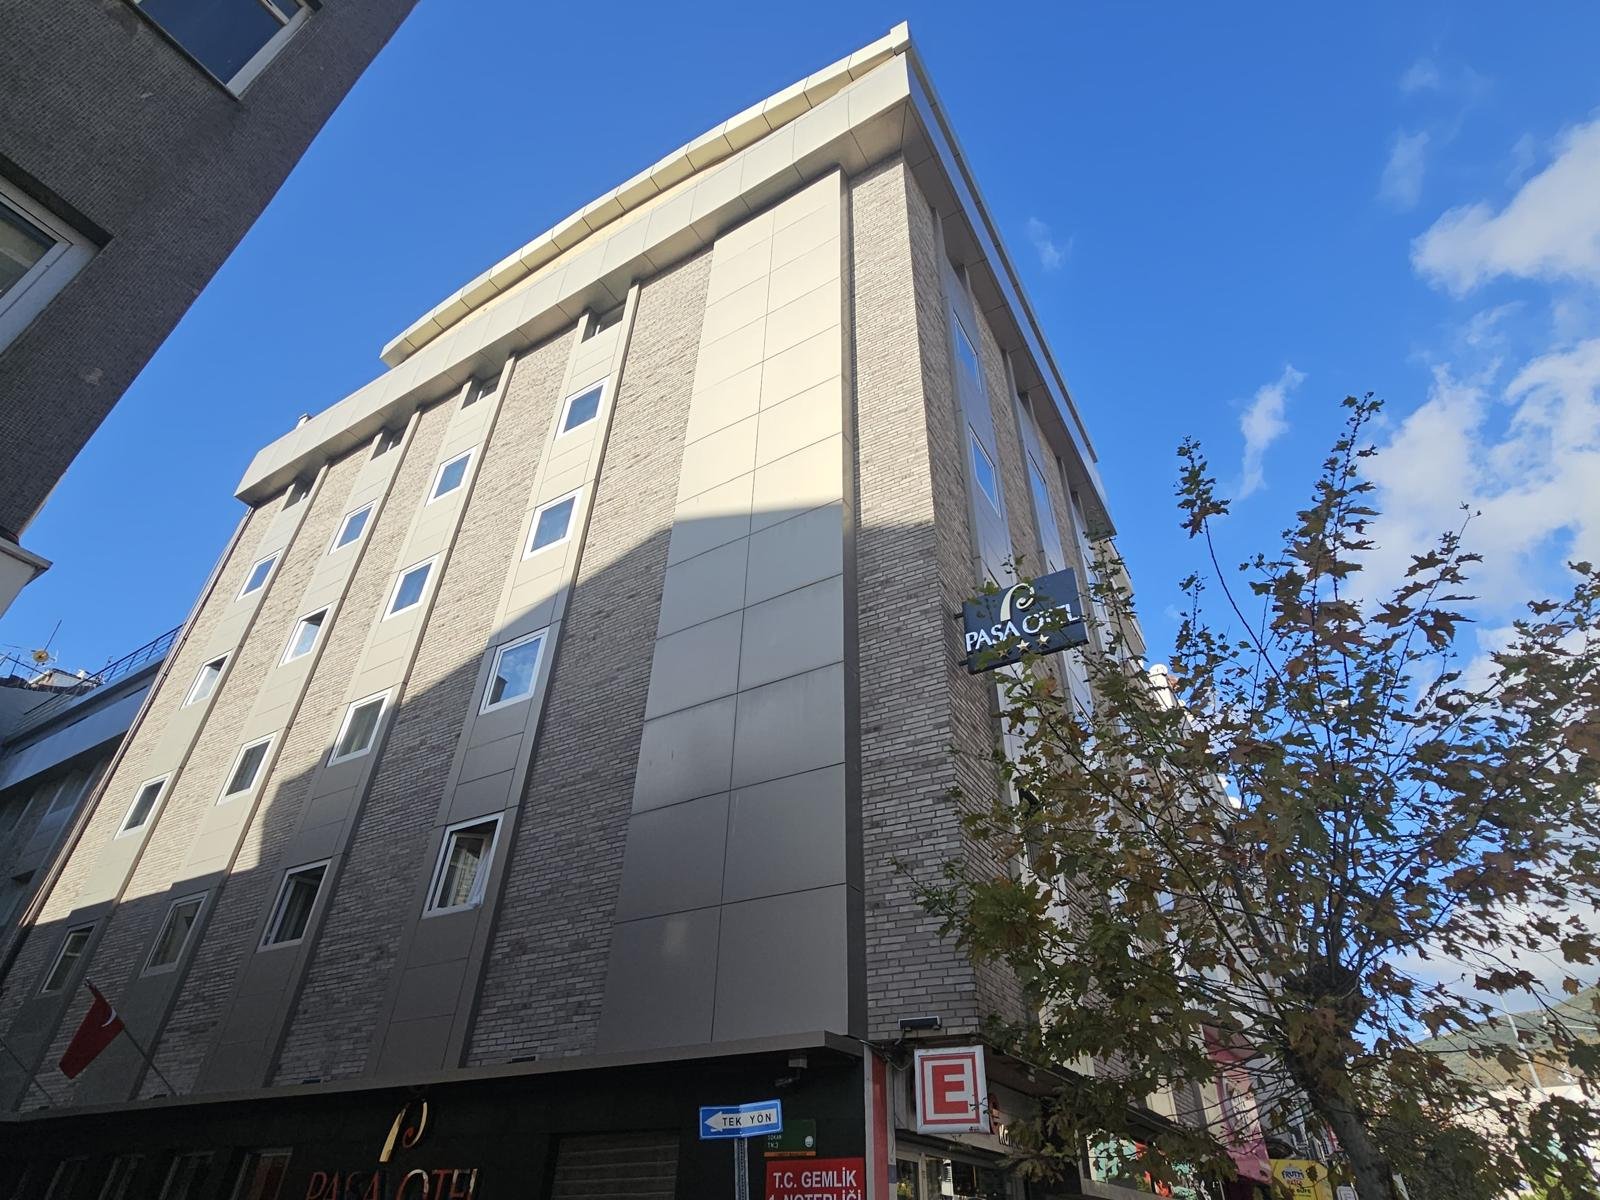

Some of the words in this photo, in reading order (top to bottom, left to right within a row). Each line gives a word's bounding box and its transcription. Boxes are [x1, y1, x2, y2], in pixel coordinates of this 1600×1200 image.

[1022, 604, 1080, 634] OL
[932, 1064, 969, 1114] E
[722, 1116, 742, 1126] TEK
[773, 1172, 797, 1189] T.C.
[801, 1167, 857, 1188] GEMLİK
